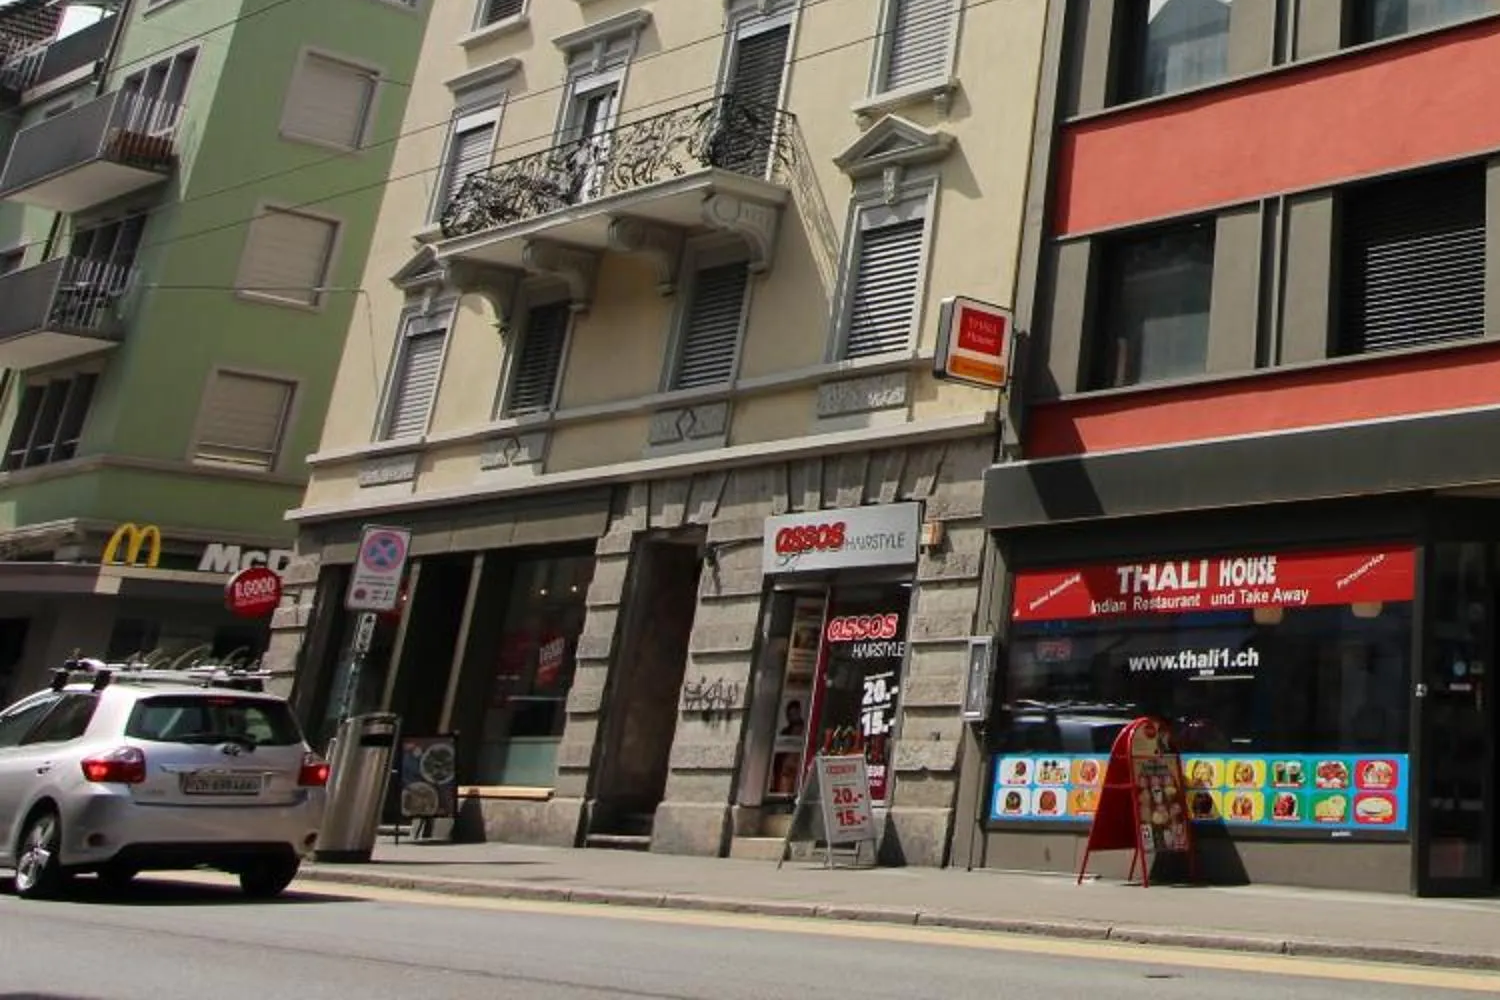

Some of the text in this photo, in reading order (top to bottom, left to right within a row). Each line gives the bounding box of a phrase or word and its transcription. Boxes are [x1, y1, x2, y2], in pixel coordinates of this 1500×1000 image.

[1117, 559, 1209, 595] THALI
[1219, 555, 1277, 588] HOUSE
[1090, 586, 1309, 614] Indian Restaurant und Take Away
[1129, 647, 1260, 672] www.thali1.ch
[862, 678, 899, 705] 20.-
[832, 787, 863, 804] 20.-
